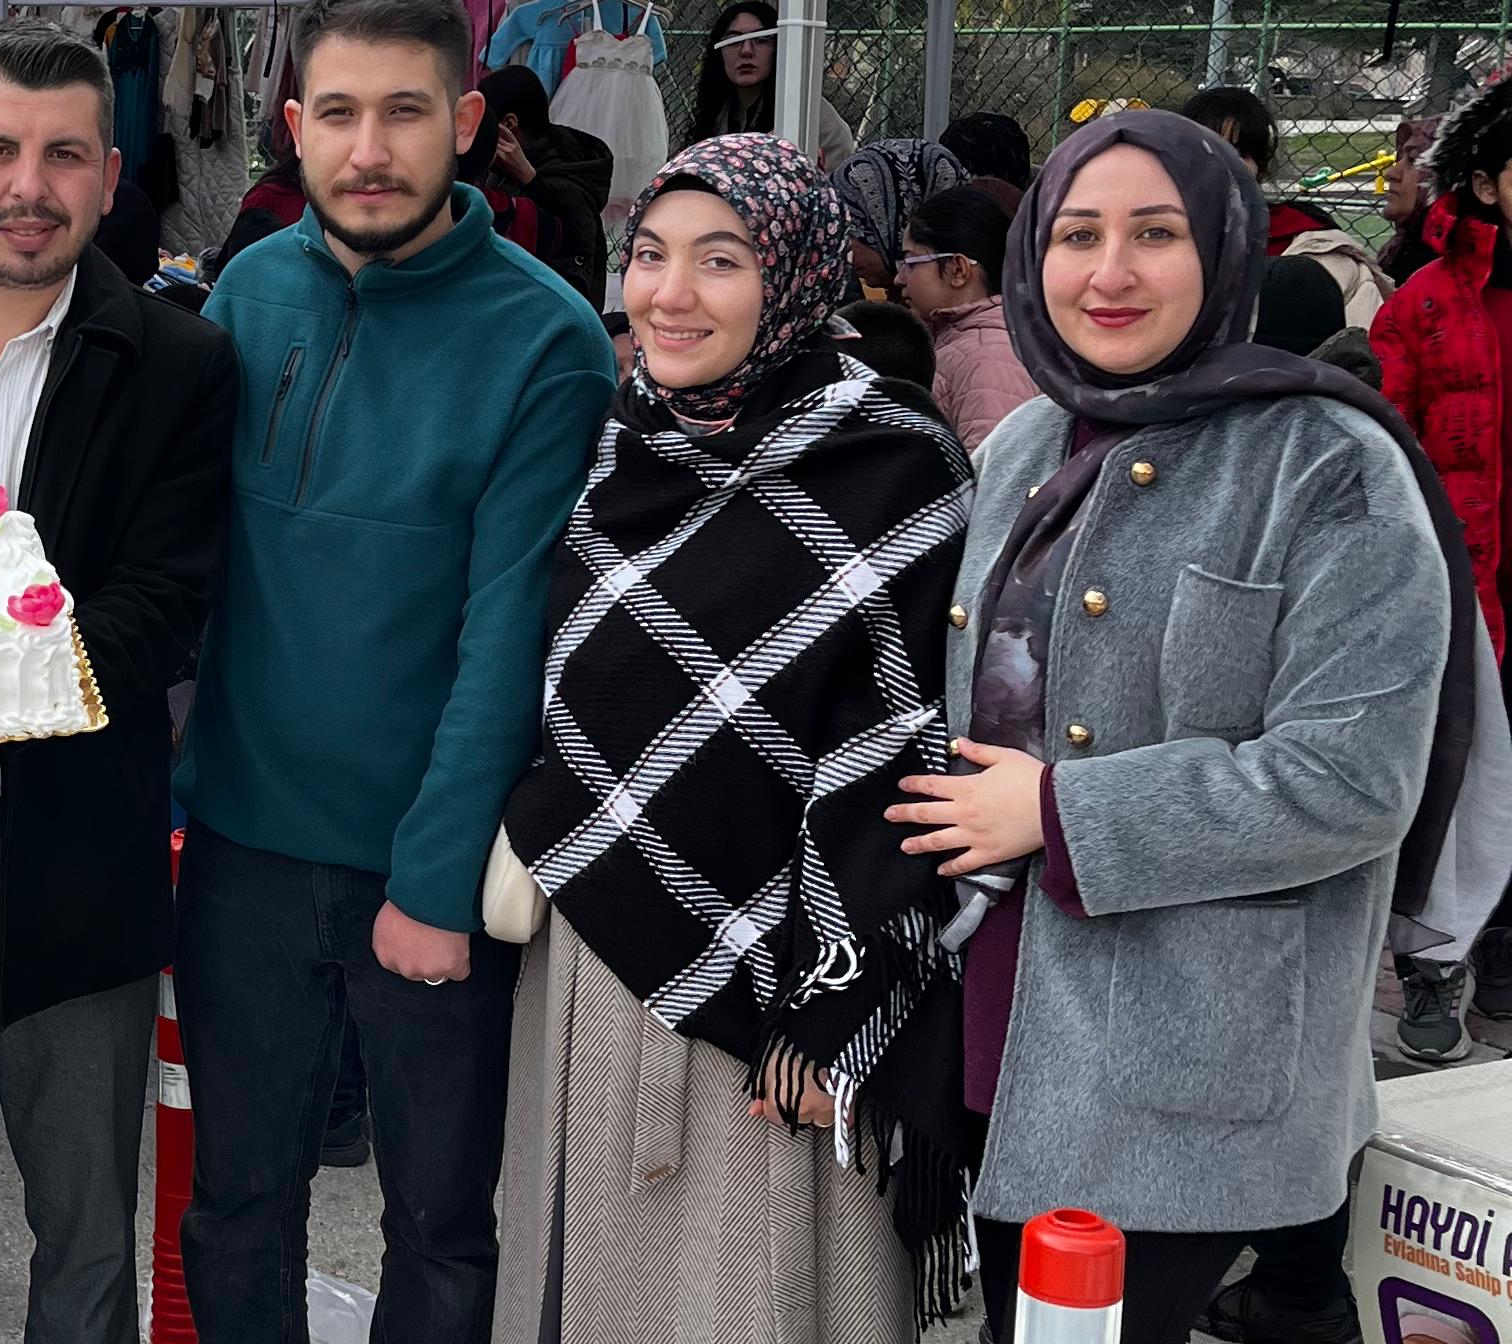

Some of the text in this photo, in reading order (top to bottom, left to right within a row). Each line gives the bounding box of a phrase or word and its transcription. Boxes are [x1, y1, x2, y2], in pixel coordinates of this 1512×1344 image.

[1380, 1184, 1496, 1268] HAYDİ
[1384, 1233, 1450, 1277] Evladına
[1455, 1261, 1501, 1297] Sahip
